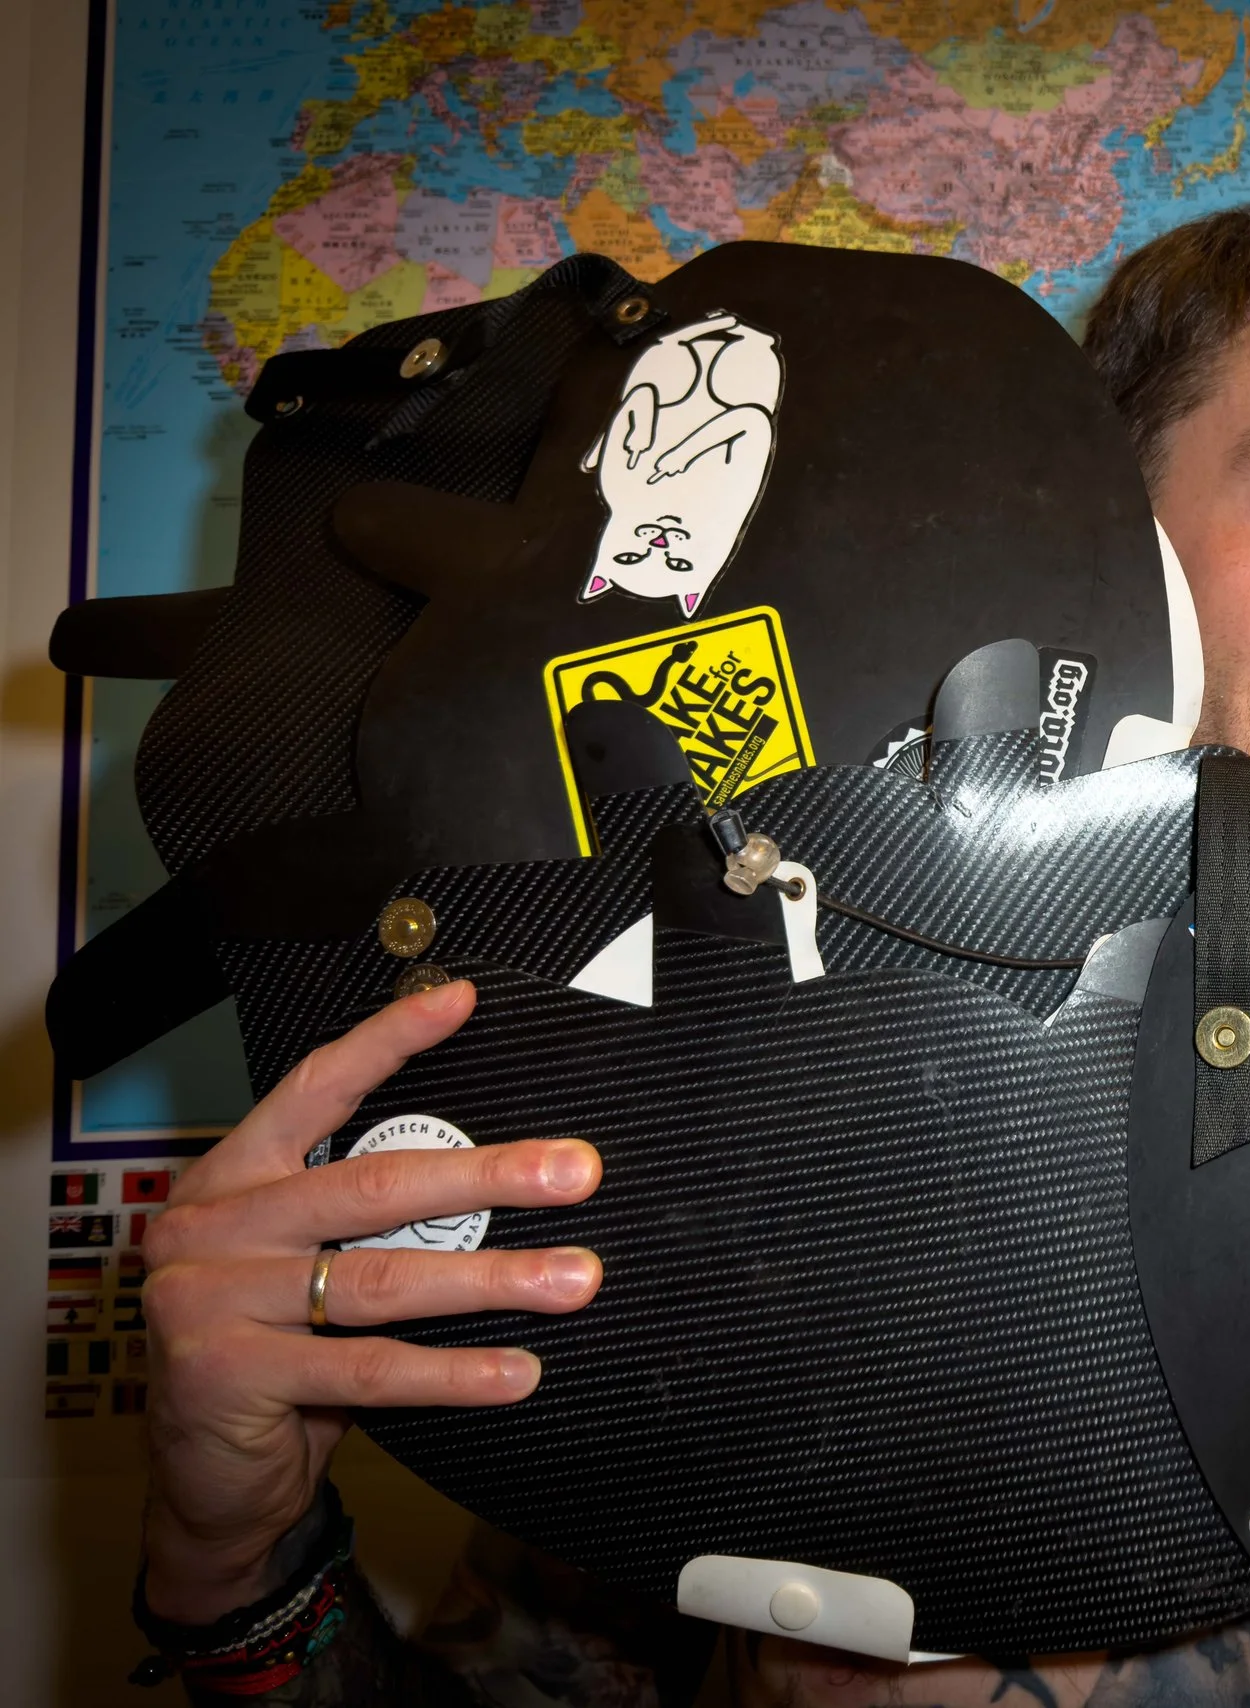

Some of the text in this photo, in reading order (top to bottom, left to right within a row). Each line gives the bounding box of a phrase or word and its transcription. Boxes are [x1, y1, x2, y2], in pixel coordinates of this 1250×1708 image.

[708, 650, 742, 683] for
[684, 668, 777, 801] AKES
[713, 734, 766, 807] savethesnakes.org
